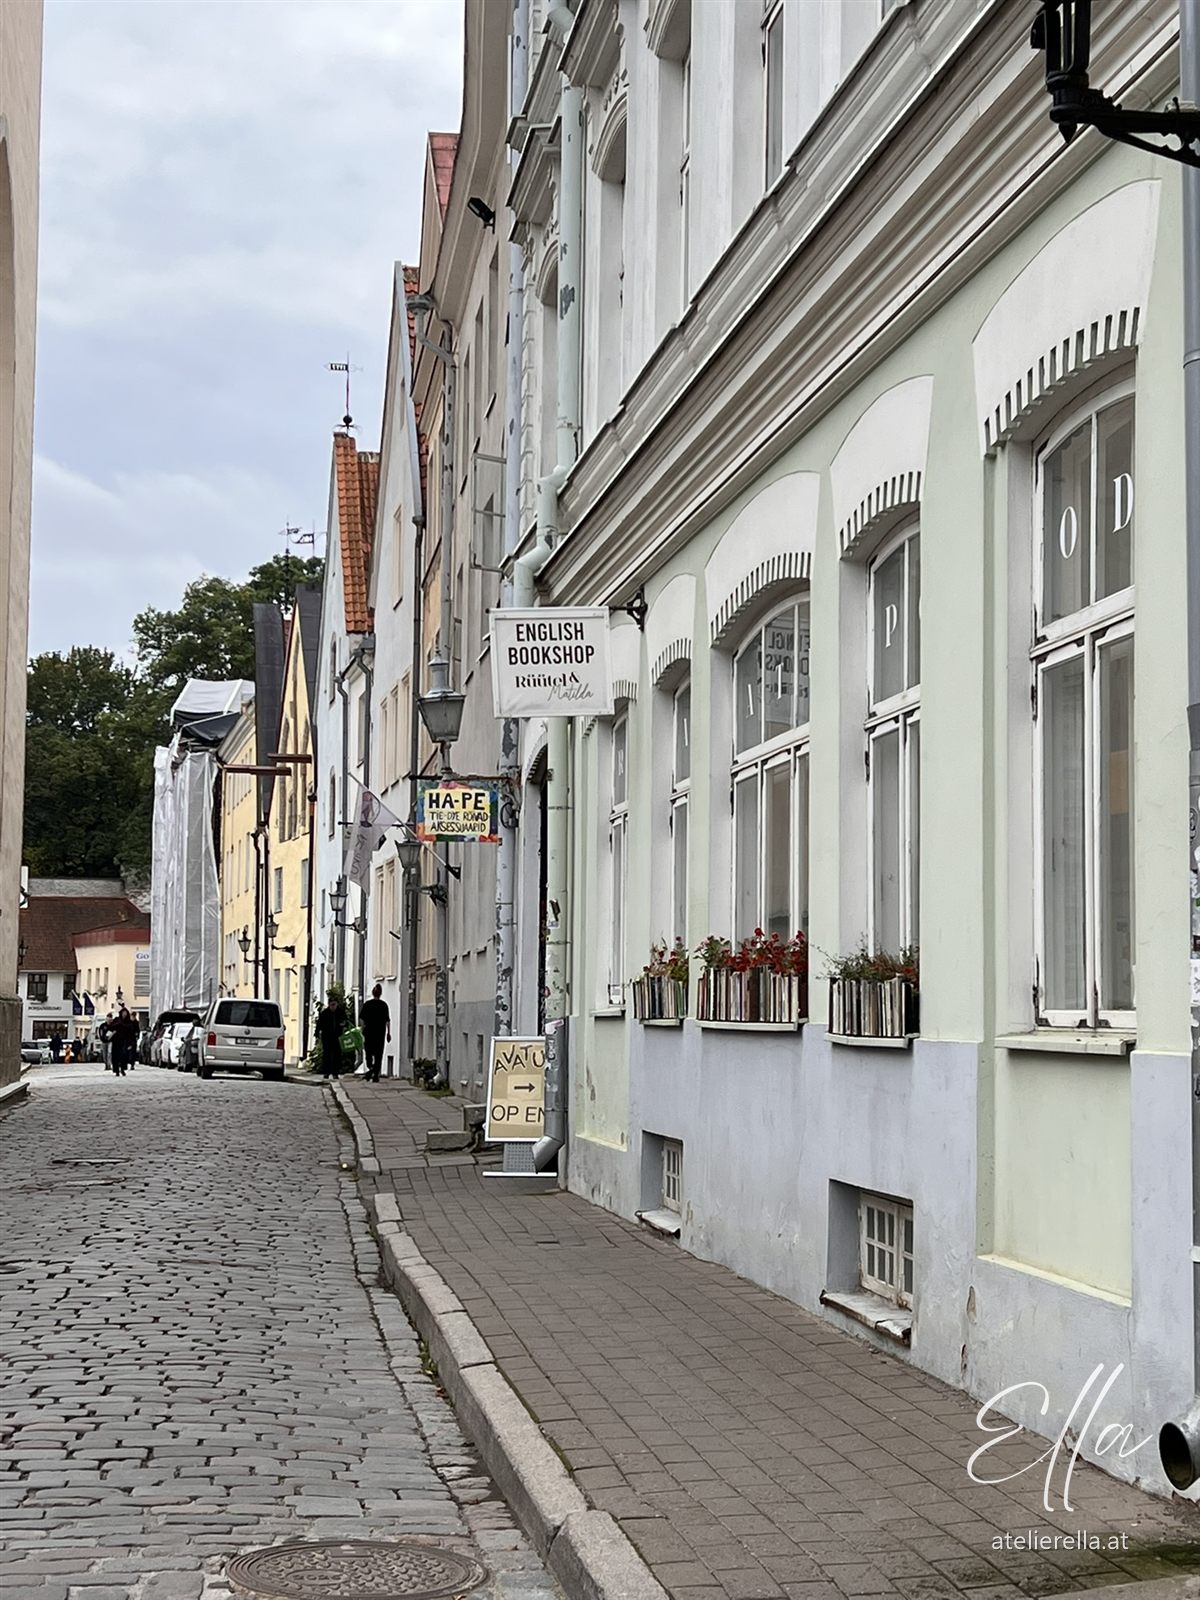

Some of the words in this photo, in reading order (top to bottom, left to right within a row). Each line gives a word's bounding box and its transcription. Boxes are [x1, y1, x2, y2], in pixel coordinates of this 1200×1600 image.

[516, 622, 585, 642] ENGLISH
[508, 645, 595, 665] BOOKSHOP
[547, 683, 594, 702] Matilda
[428, 792, 486, 810] HA-PE
